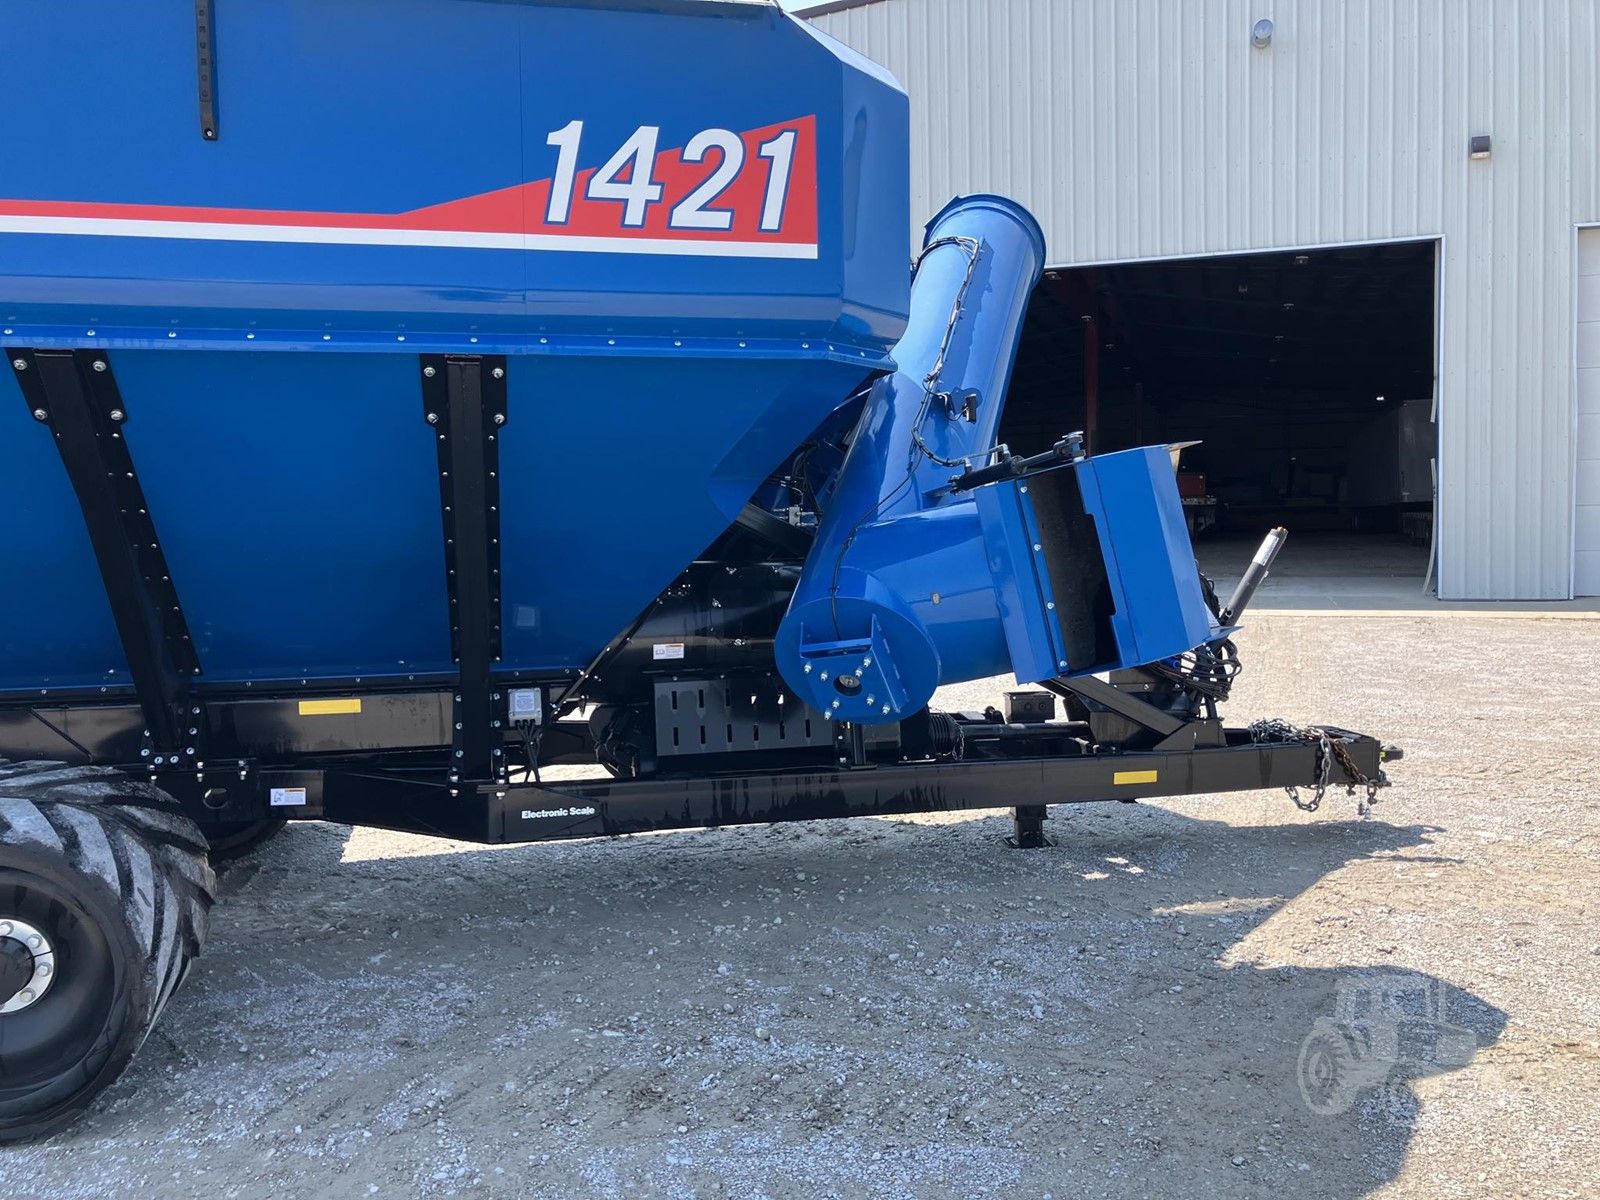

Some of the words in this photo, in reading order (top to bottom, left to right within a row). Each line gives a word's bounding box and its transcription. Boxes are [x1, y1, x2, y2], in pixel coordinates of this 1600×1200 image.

[545, 120, 798, 232] 1421
[521, 808, 568, 819] Electronic
[569, 806, 596, 816] Scale
